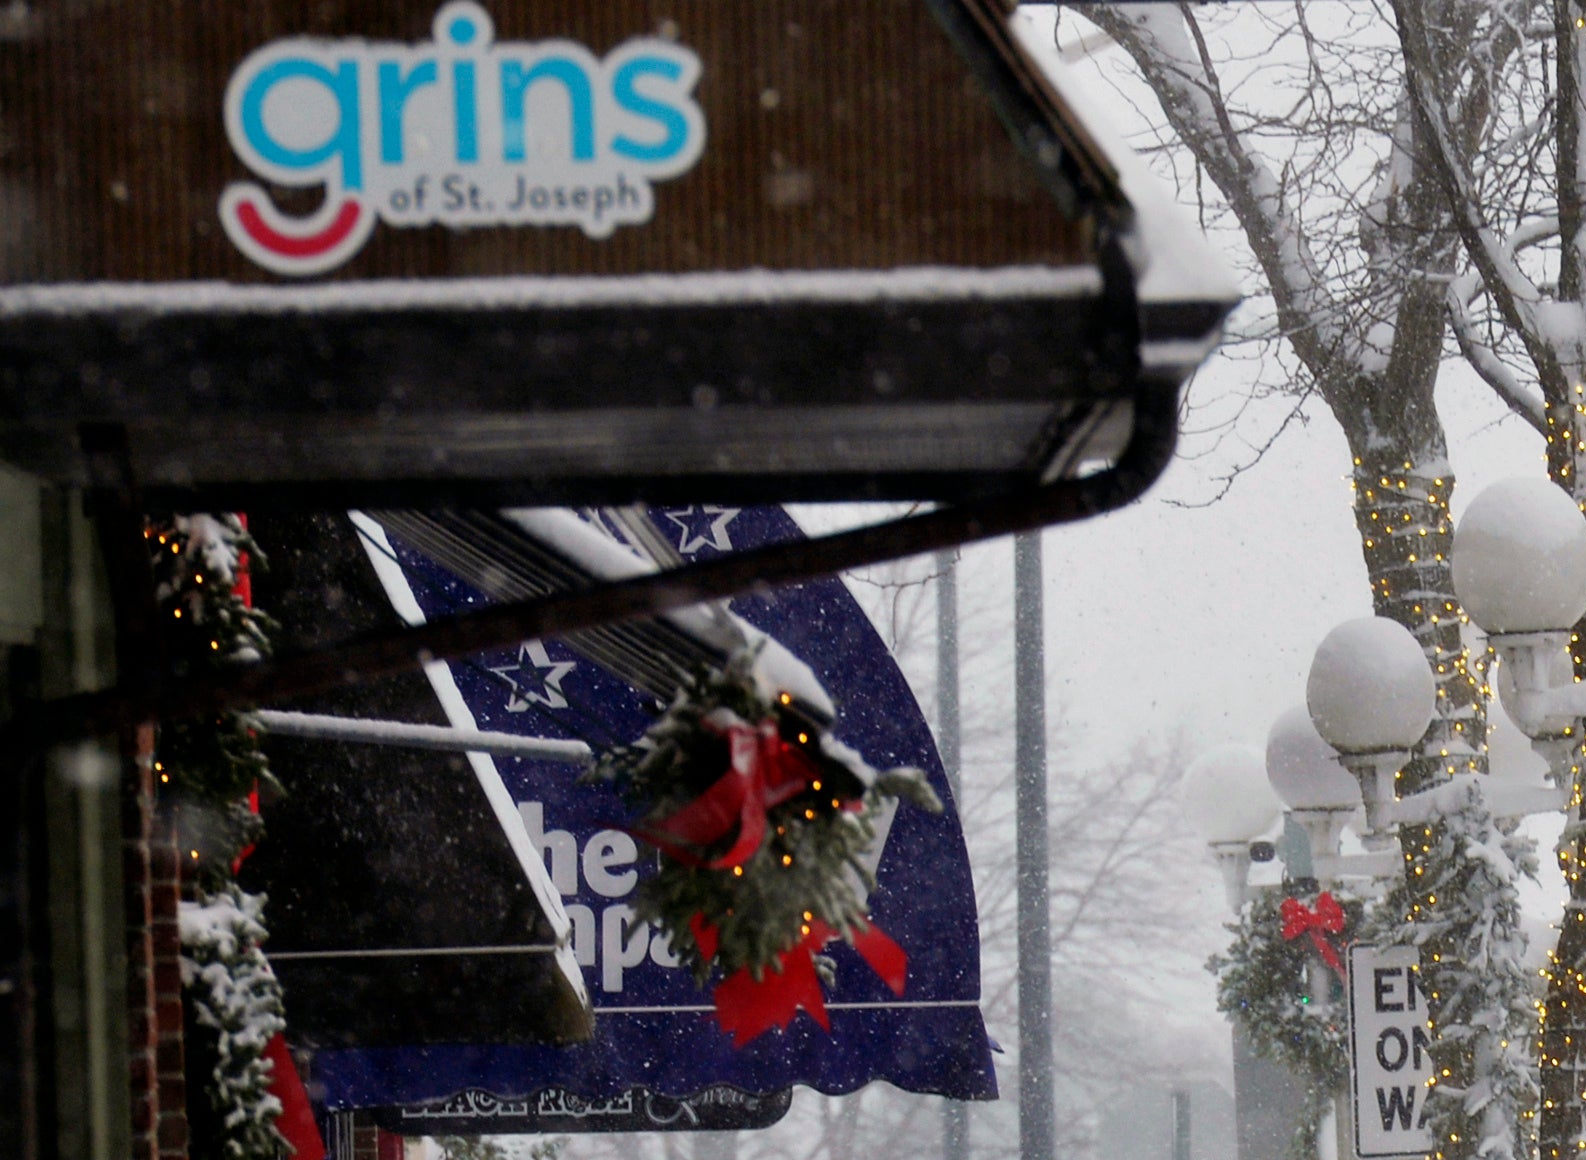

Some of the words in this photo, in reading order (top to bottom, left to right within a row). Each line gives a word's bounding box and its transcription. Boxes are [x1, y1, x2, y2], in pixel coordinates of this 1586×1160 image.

[235, 17, 688, 258] grins
[389, 175, 429, 213] of
[441, 175, 497, 213] St.
[507, 172, 641, 221] Joseph
[517, 801, 638, 898] he
